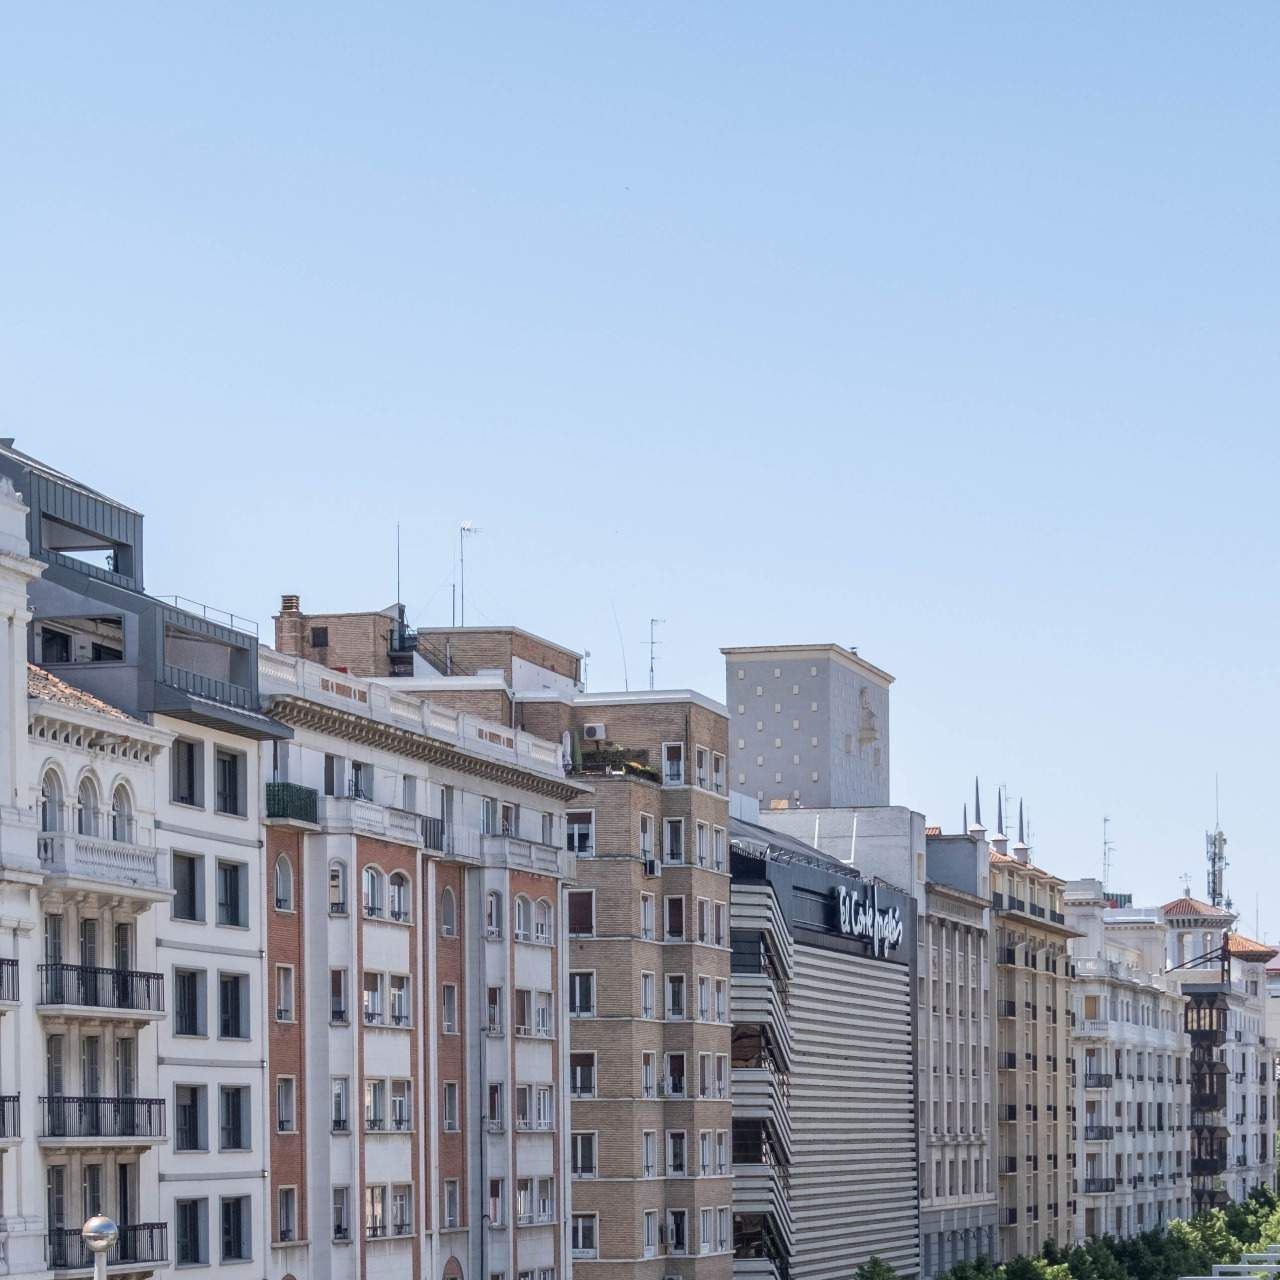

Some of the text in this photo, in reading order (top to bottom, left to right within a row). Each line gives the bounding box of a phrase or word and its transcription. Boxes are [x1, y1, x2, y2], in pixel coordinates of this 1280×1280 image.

[837, 884, 904, 958] El Corte Inglés
